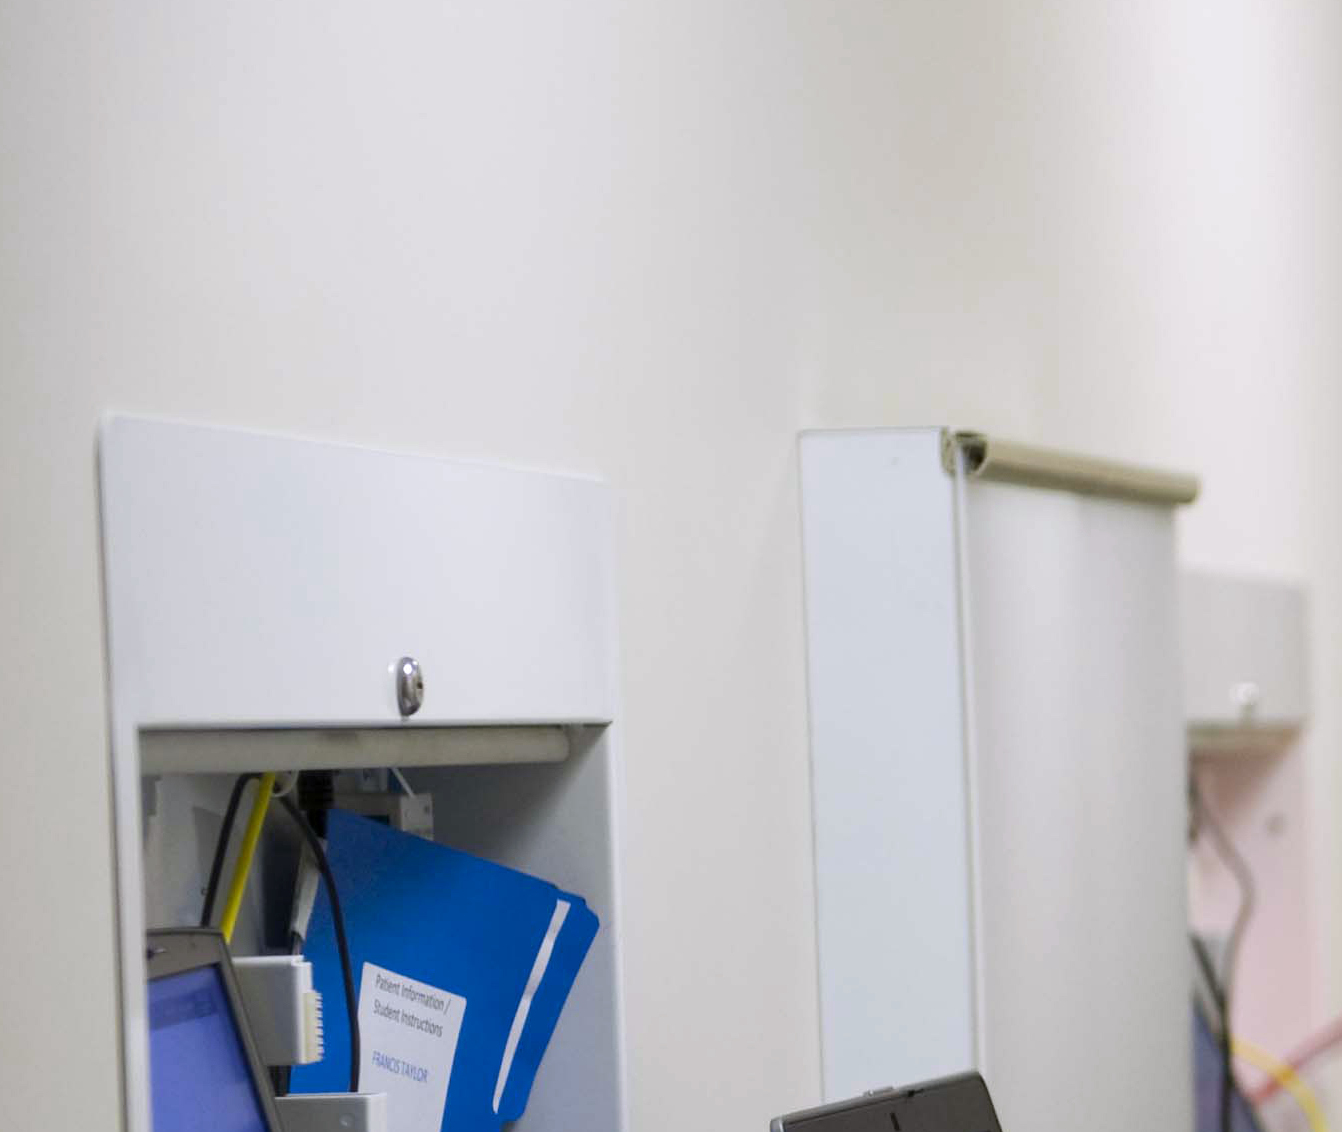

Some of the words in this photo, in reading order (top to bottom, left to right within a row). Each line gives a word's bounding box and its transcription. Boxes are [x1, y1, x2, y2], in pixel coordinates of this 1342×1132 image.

[375, 974, 400, 996] Patient
[401, 985, 444, 1011] Information
[373, 999, 400, 1023] Student
[401, 1009, 443, 1038] Instructions
[371, 1050, 400, 1074] FRANCIS
[402, 1061, 428, 1083] TAYLOR
